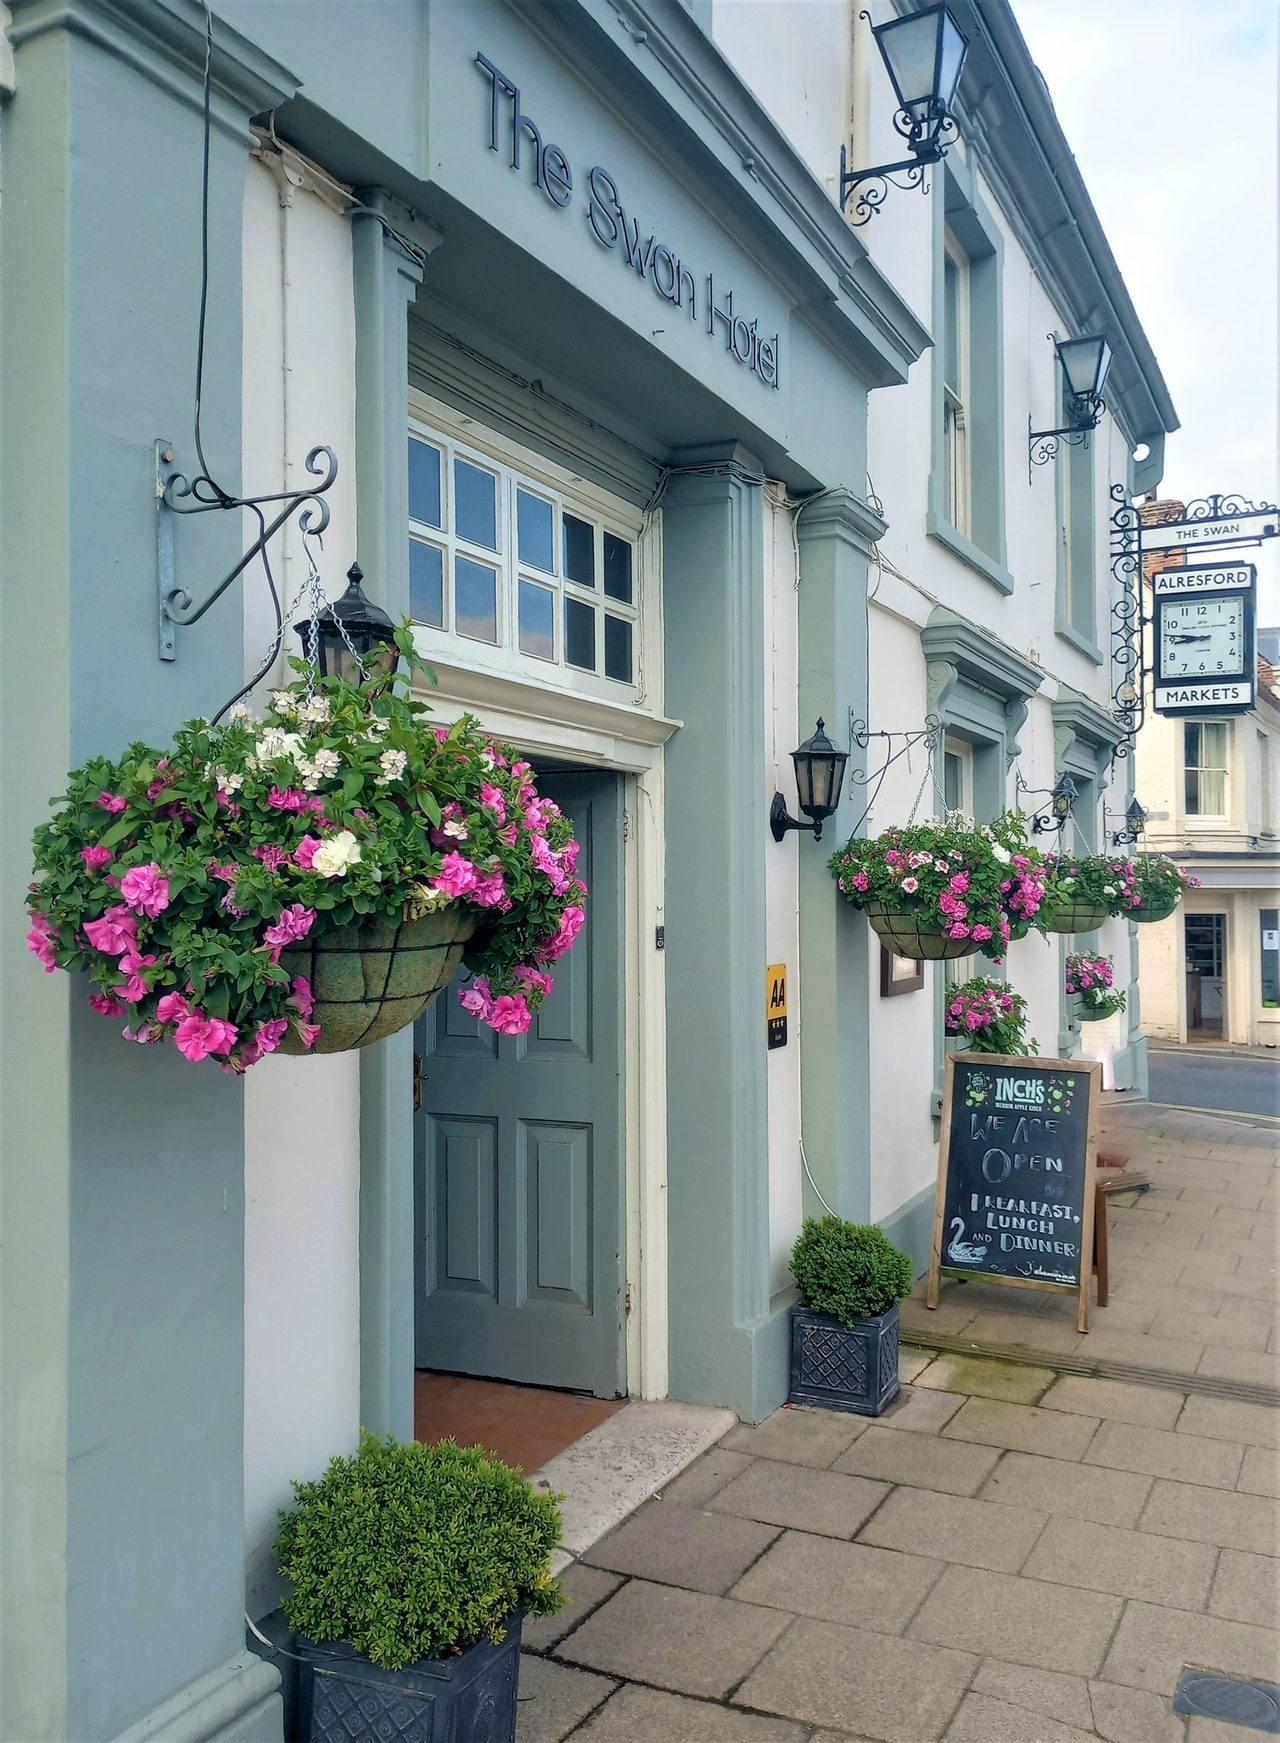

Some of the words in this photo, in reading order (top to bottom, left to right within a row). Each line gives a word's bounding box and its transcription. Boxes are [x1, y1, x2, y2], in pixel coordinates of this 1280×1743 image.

[475, 51, 573, 209] The
[587, 165, 698, 321] Swan
[706, 272, 781, 391] Hotel
[1176, 530, 1199, 540] THE
[1203, 524, 1240, 536] SWAN
[1158, 571, 1248, 590] ALRESFORD
[1181, 608, 1189, 616] 11
[1197, 606, 1207, 615] 12
[1217, 605, 1221, 613] 1
[1167, 620, 1178, 629] 10
[1229, 616, 1236, 624] 2
[1229, 632, 1236, 640] 3
[1169, 652, 1176, 661] 8
[1228, 648, 1236, 656] 4
[1181, 663, 1188, 672] 7
[1199, 662, 1205, 670] 6
[1217, 661, 1223, 670] 5
[1166, 687, 1240, 703] MARKETS
[770, 978, 785, 1009] AA
[994, 1077, 1045, 1104] INCH'S
[970, 1113, 1006, 1141] WE
[982, 1148, 1063, 1183] OPEN
[986, 1212, 1054, 1235] LUNCH
[972, 1233, 993, 1243] AND
